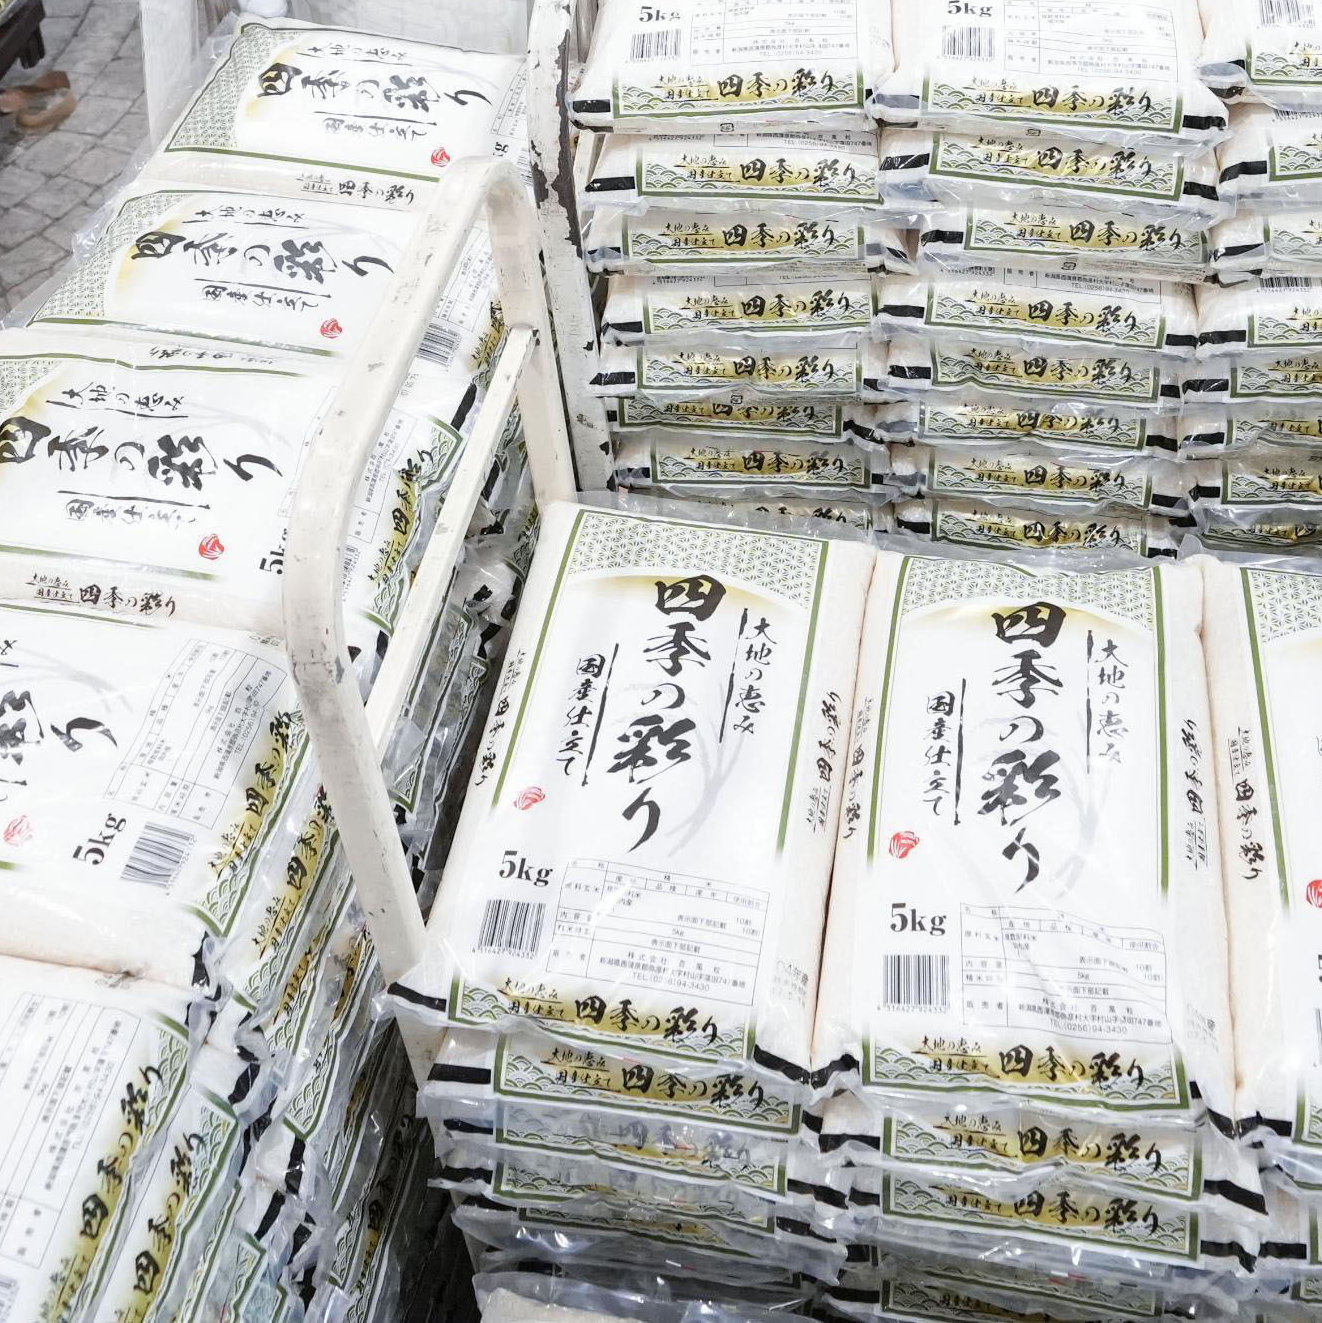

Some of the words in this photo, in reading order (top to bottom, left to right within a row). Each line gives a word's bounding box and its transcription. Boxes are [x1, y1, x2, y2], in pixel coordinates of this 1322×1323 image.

[638, 5, 682, 25] 5kg
[946, 0, 993, 19] 5kg
[498, 850, 553, 887] 5kg
[889, 901, 947, 937] 5kg
